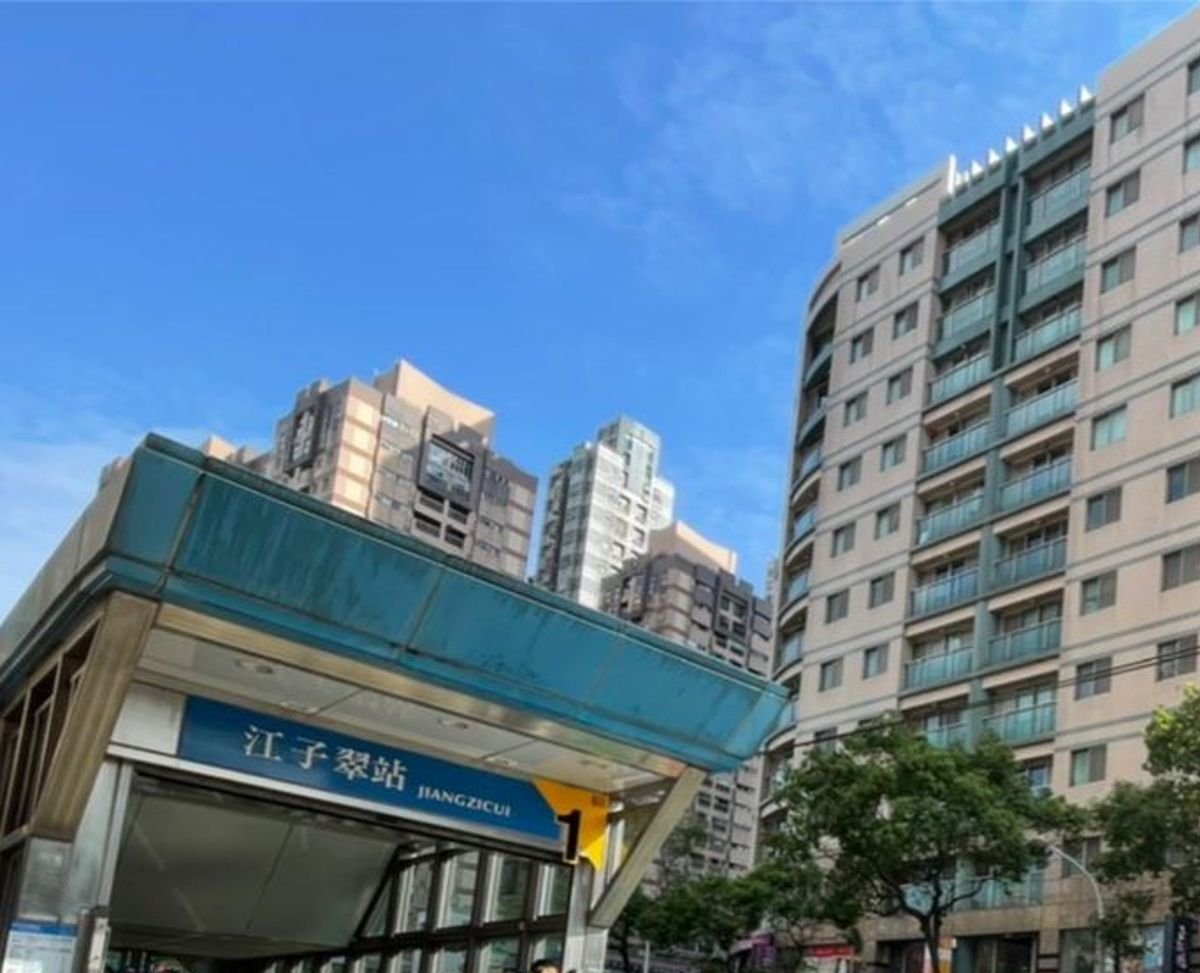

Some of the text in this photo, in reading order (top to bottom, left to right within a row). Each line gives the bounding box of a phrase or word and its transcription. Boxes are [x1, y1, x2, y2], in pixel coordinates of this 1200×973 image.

[242, 724, 407, 792] 江子翠站
[416, 785, 512, 818] JIANGZICUI
[557, 808, 582, 862] 1
